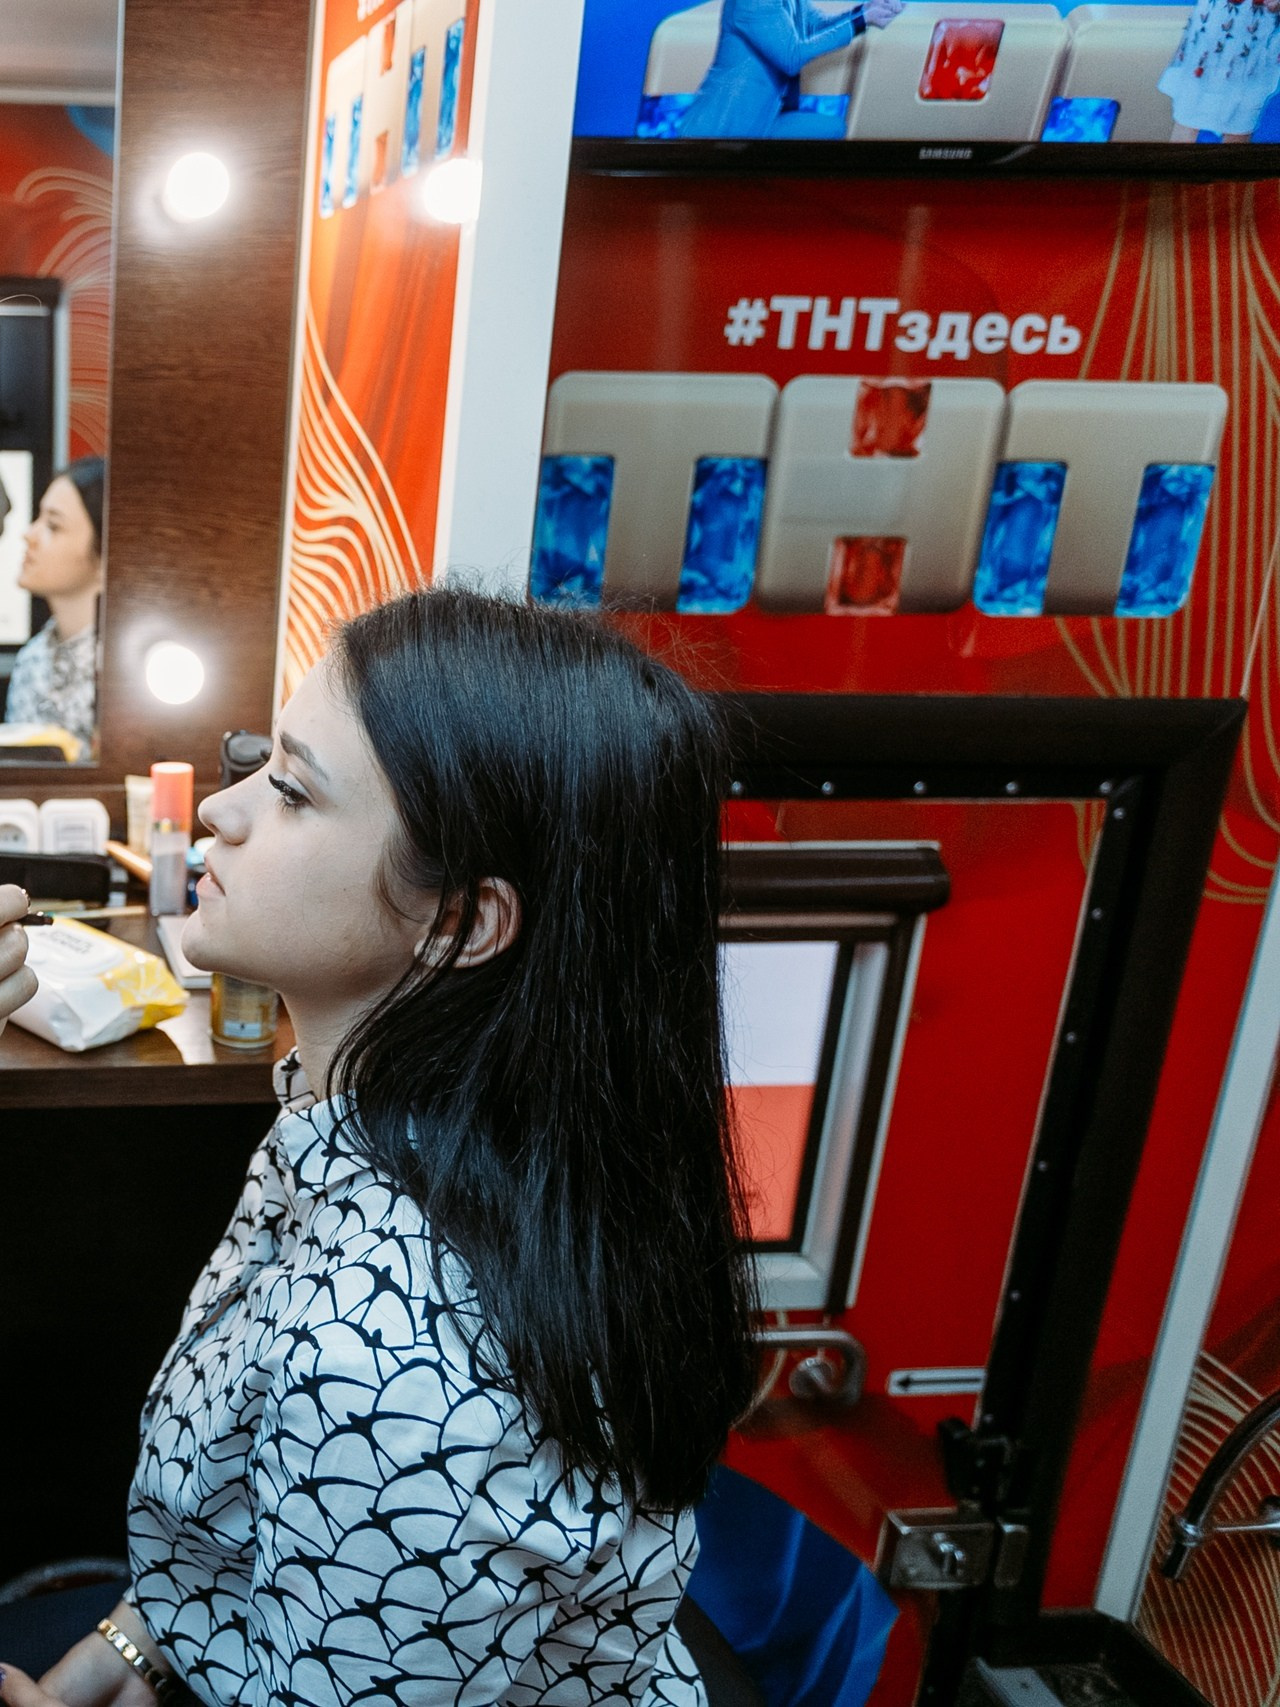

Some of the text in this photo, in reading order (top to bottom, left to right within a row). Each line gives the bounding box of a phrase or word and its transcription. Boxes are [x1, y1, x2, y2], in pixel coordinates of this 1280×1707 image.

[919, 146, 973, 159] SAMSUNG
[723, 294, 1081, 360] #ТНТздесь
[530, 370, 1229, 618] ТНТ
